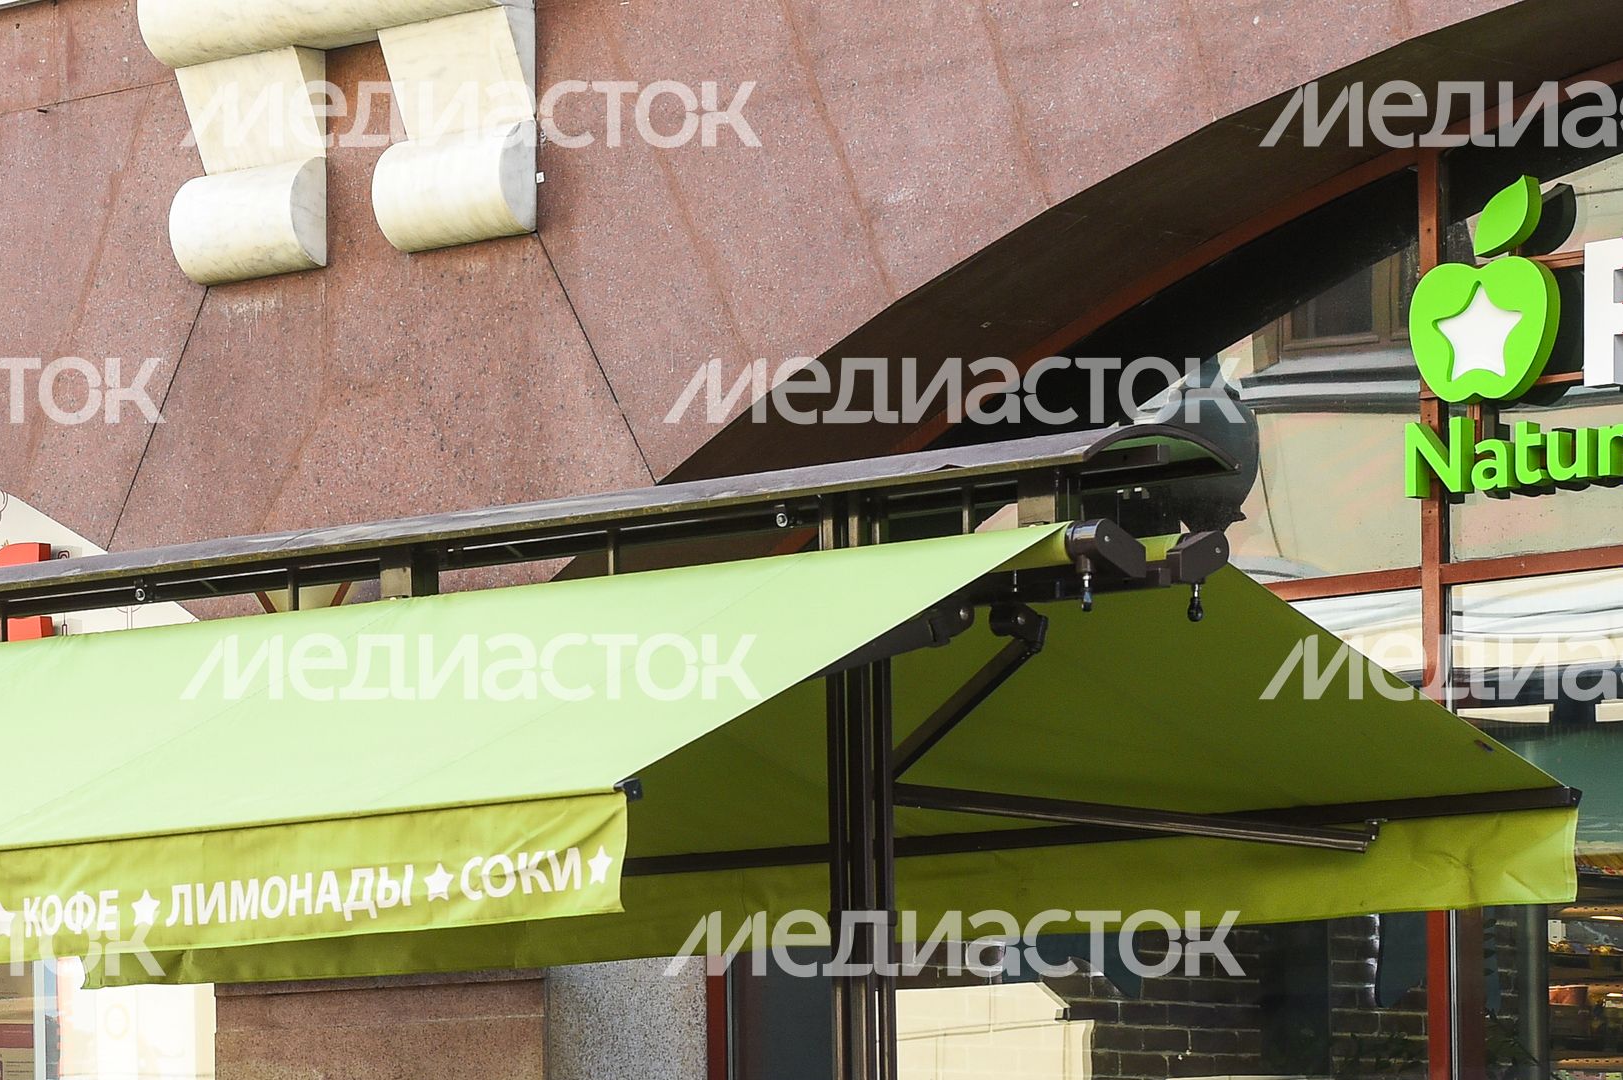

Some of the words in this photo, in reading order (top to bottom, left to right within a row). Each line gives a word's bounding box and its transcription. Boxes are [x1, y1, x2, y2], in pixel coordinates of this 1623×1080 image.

[23, 890, 119, 938] КОФЕ
[165, 864, 412, 927] ЛИМОНАДЫ
[459, 848, 582, 901] СОКИ
